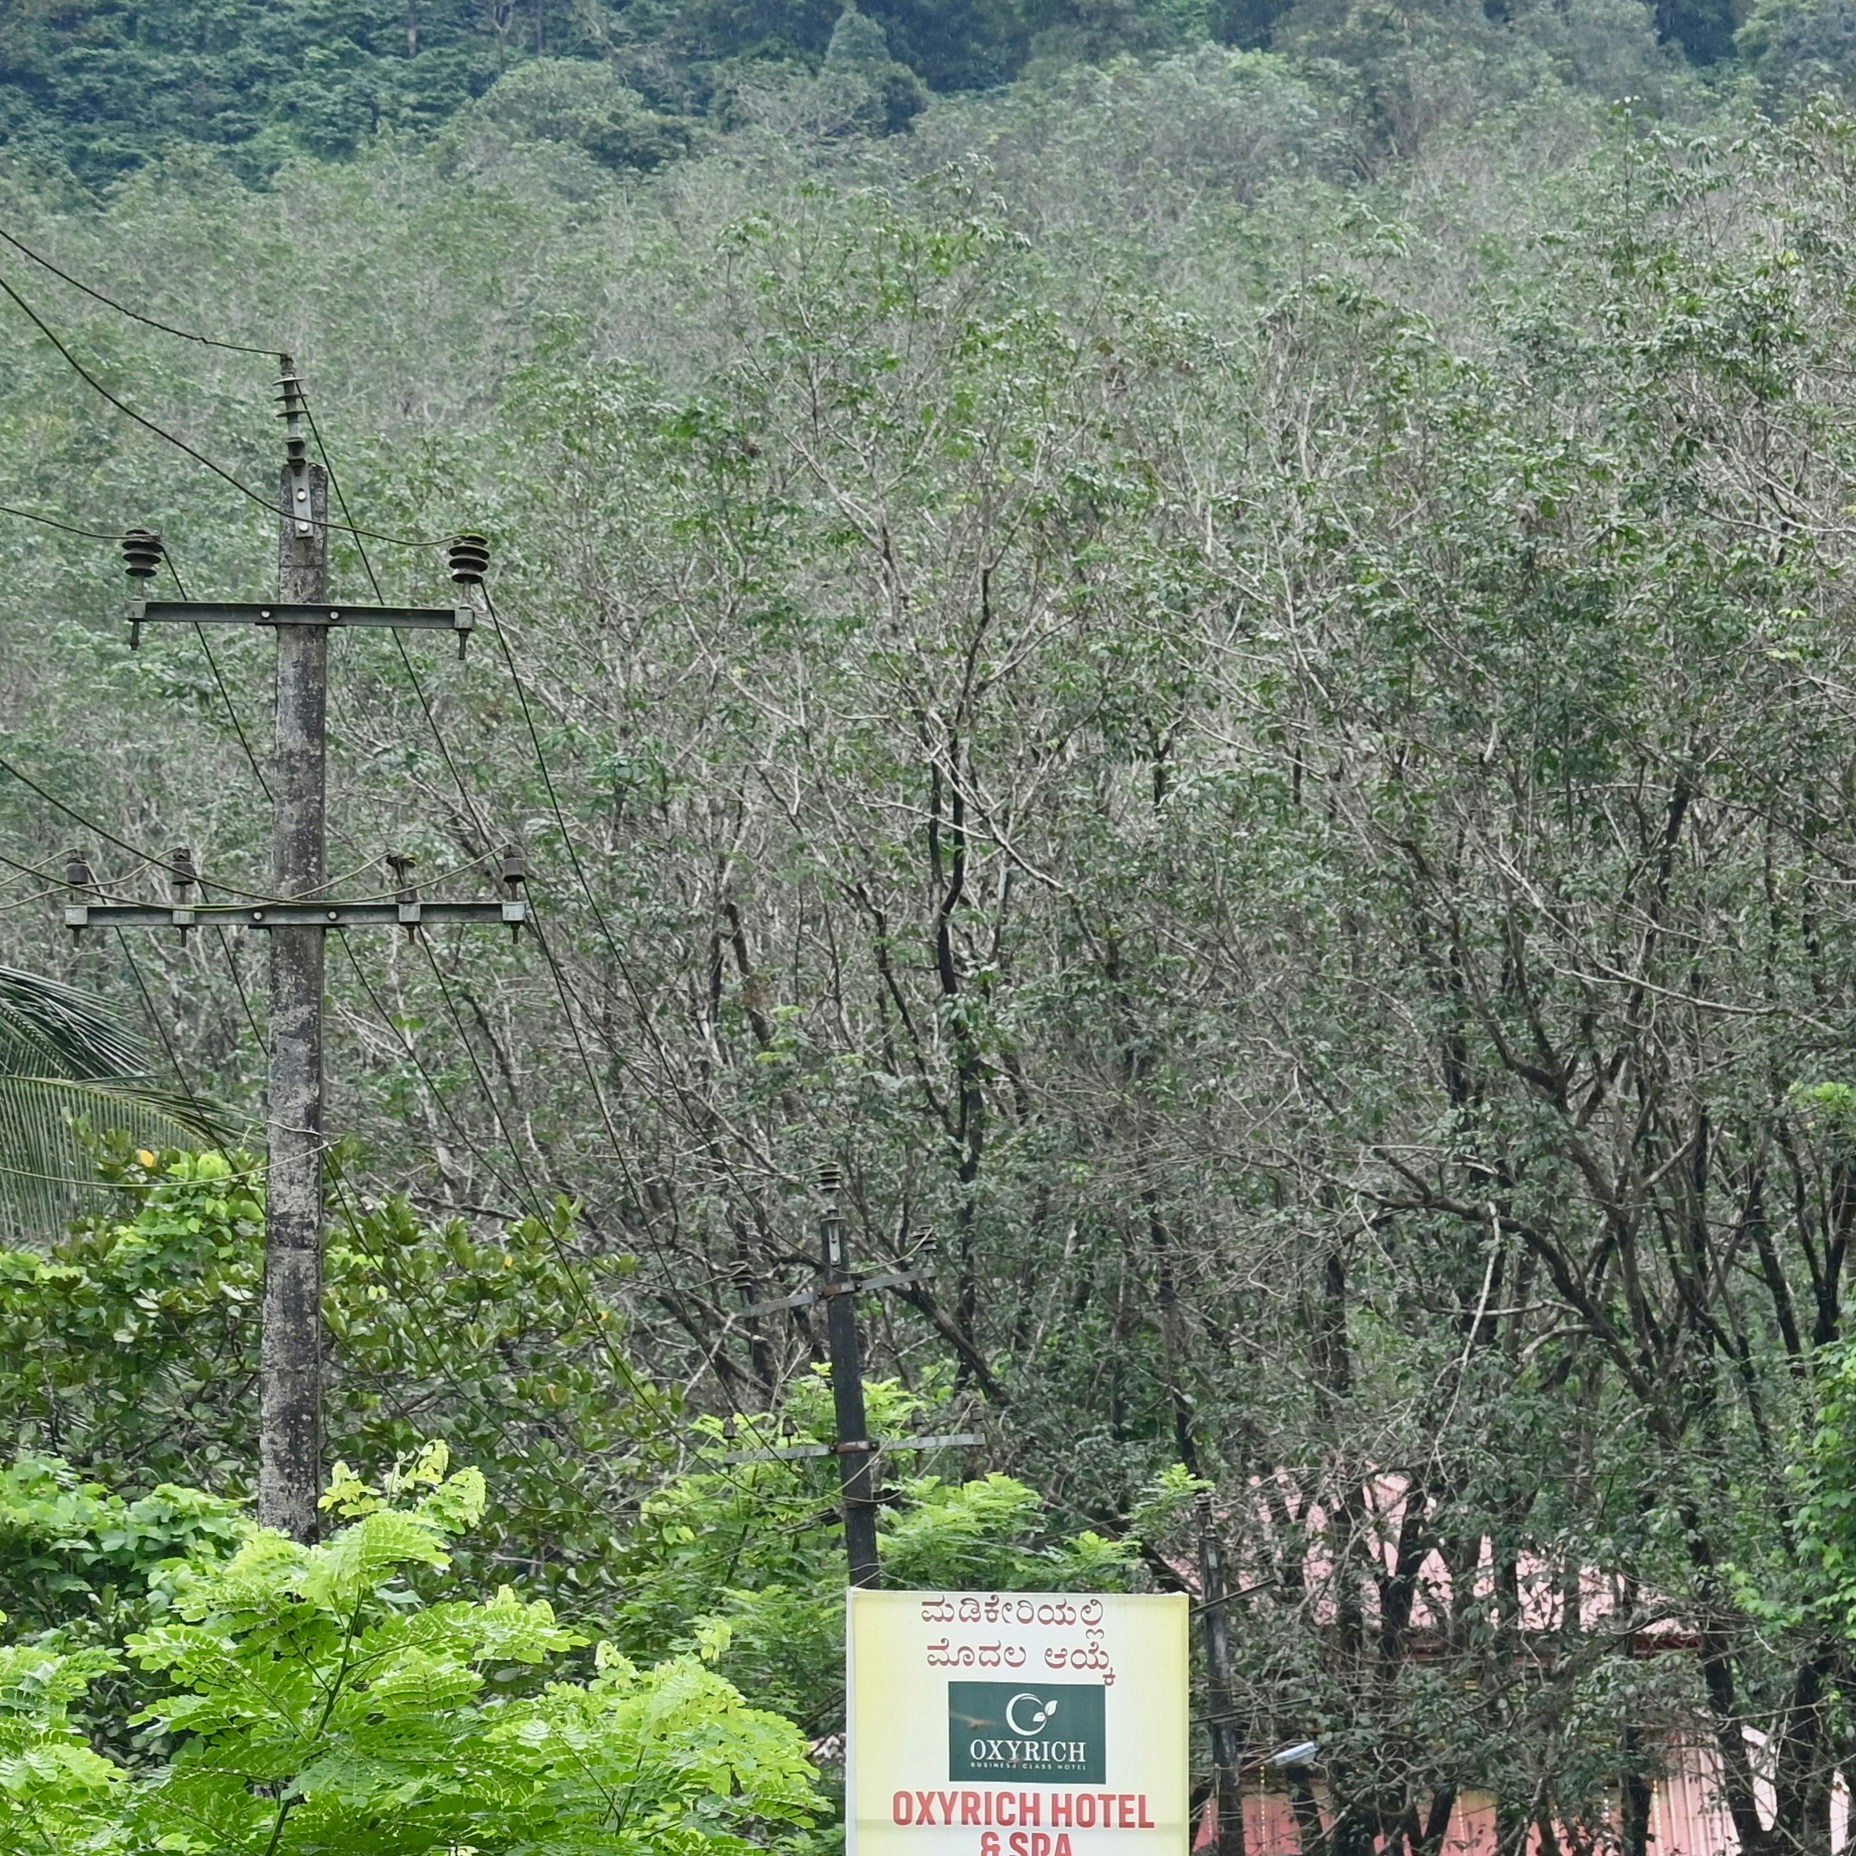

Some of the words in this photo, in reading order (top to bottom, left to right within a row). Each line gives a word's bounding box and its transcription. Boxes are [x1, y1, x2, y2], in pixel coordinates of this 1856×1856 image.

[921, 1594, 1105, 1639] ಮಡಿಕೇರಿಯಲ್ಲಿ
[926, 1637, 1027, 1668] ಮೊದಲ
[1044, 1641, 1116, 1686] ಆಯ್ಕೆ
[970, 1739, 1087, 1763] OXYRICH
[892, 1791, 1041, 1827] OXYRICH
[1051, 1793, 1156, 1829] HOTEL
